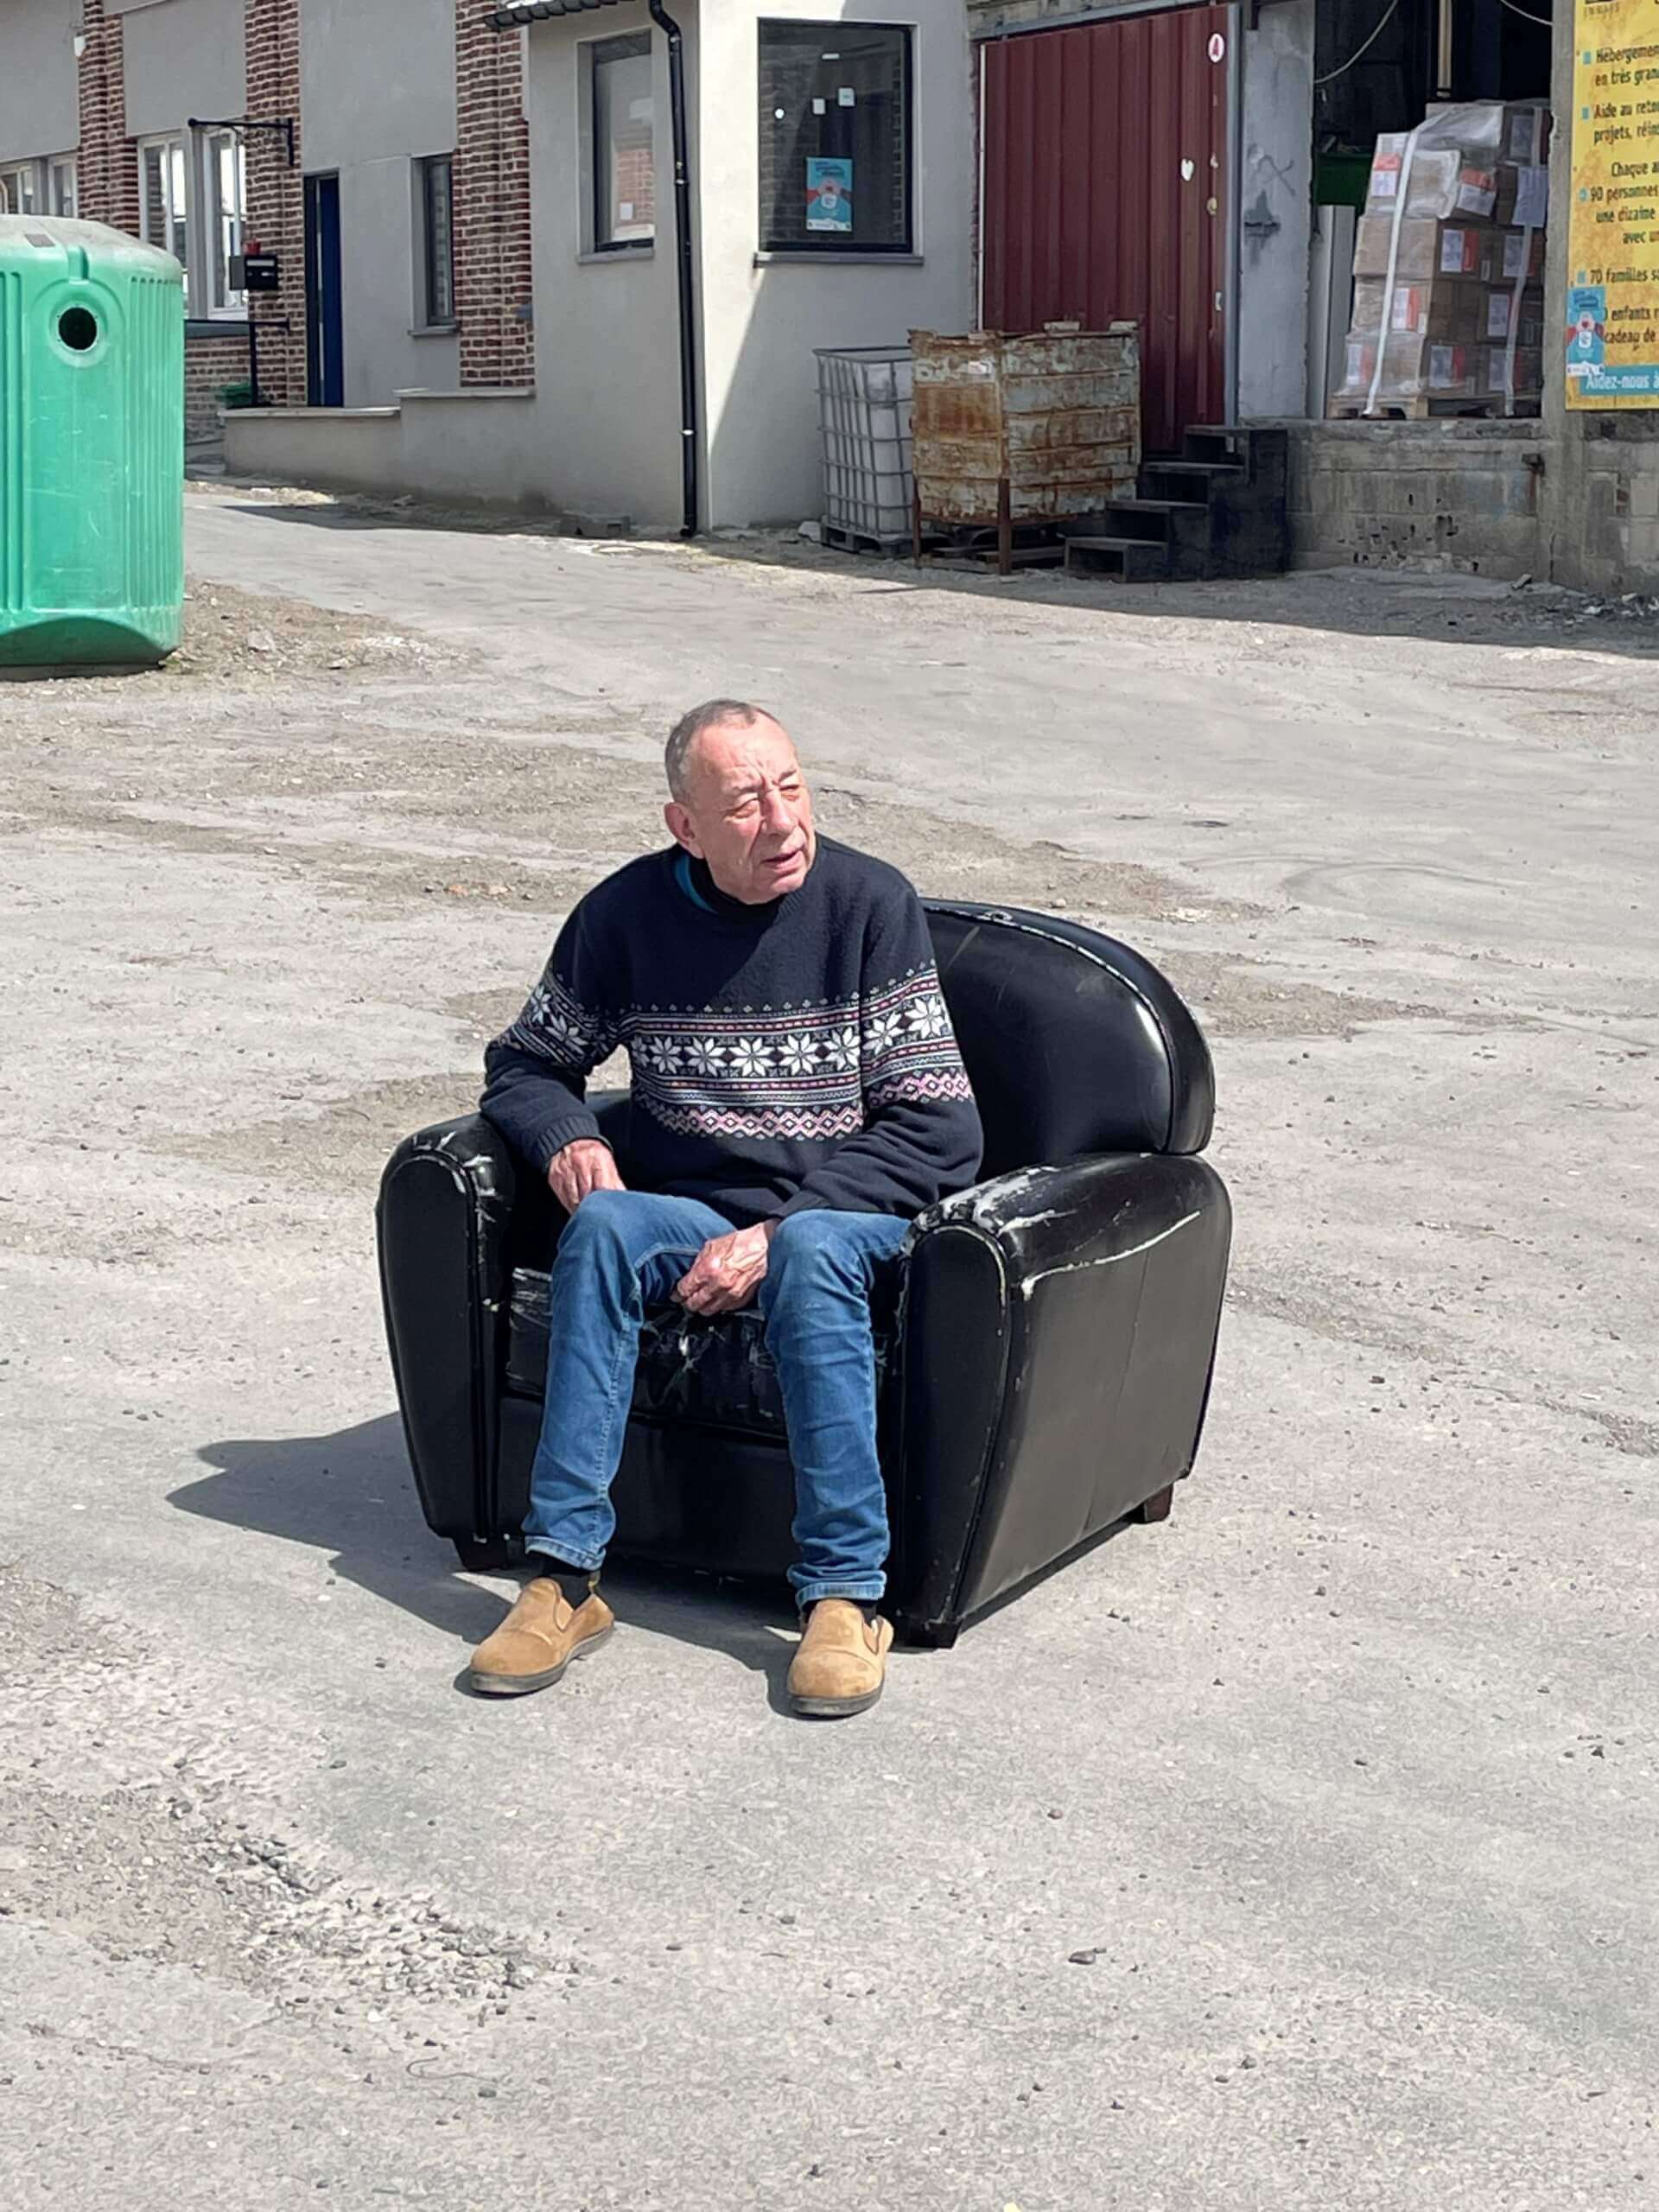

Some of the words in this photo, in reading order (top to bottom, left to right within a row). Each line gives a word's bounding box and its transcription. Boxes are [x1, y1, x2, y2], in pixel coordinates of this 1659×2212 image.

[1595, 74, 1607, 86] en
[1611, 69, 1630, 84] très
[1593, 102, 1617, 118] Aide
[1620, 105, 1632, 116] au
[1594, 124, 1632, 145] projets,
[1611, 162, 1648, 179] Chaque
[1591, 186, 1604, 202] 90
[1607, 185, 1658, 205] personnes
[1596, 211, 1614, 223] une
[1618, 206, 1656, 221] dizaine
[1623, 231, 1646, 244] avec
[1590, 269, 1603, 284] 70
[1605, 267, 1648, 283] familles
[1611, 305, 1650, 321] enfants
[1605, 328, 1640, 344] cadeau
[1643, 327, 1656, 343] de
[1586, 374, 1649, 390] Aidez-nous
